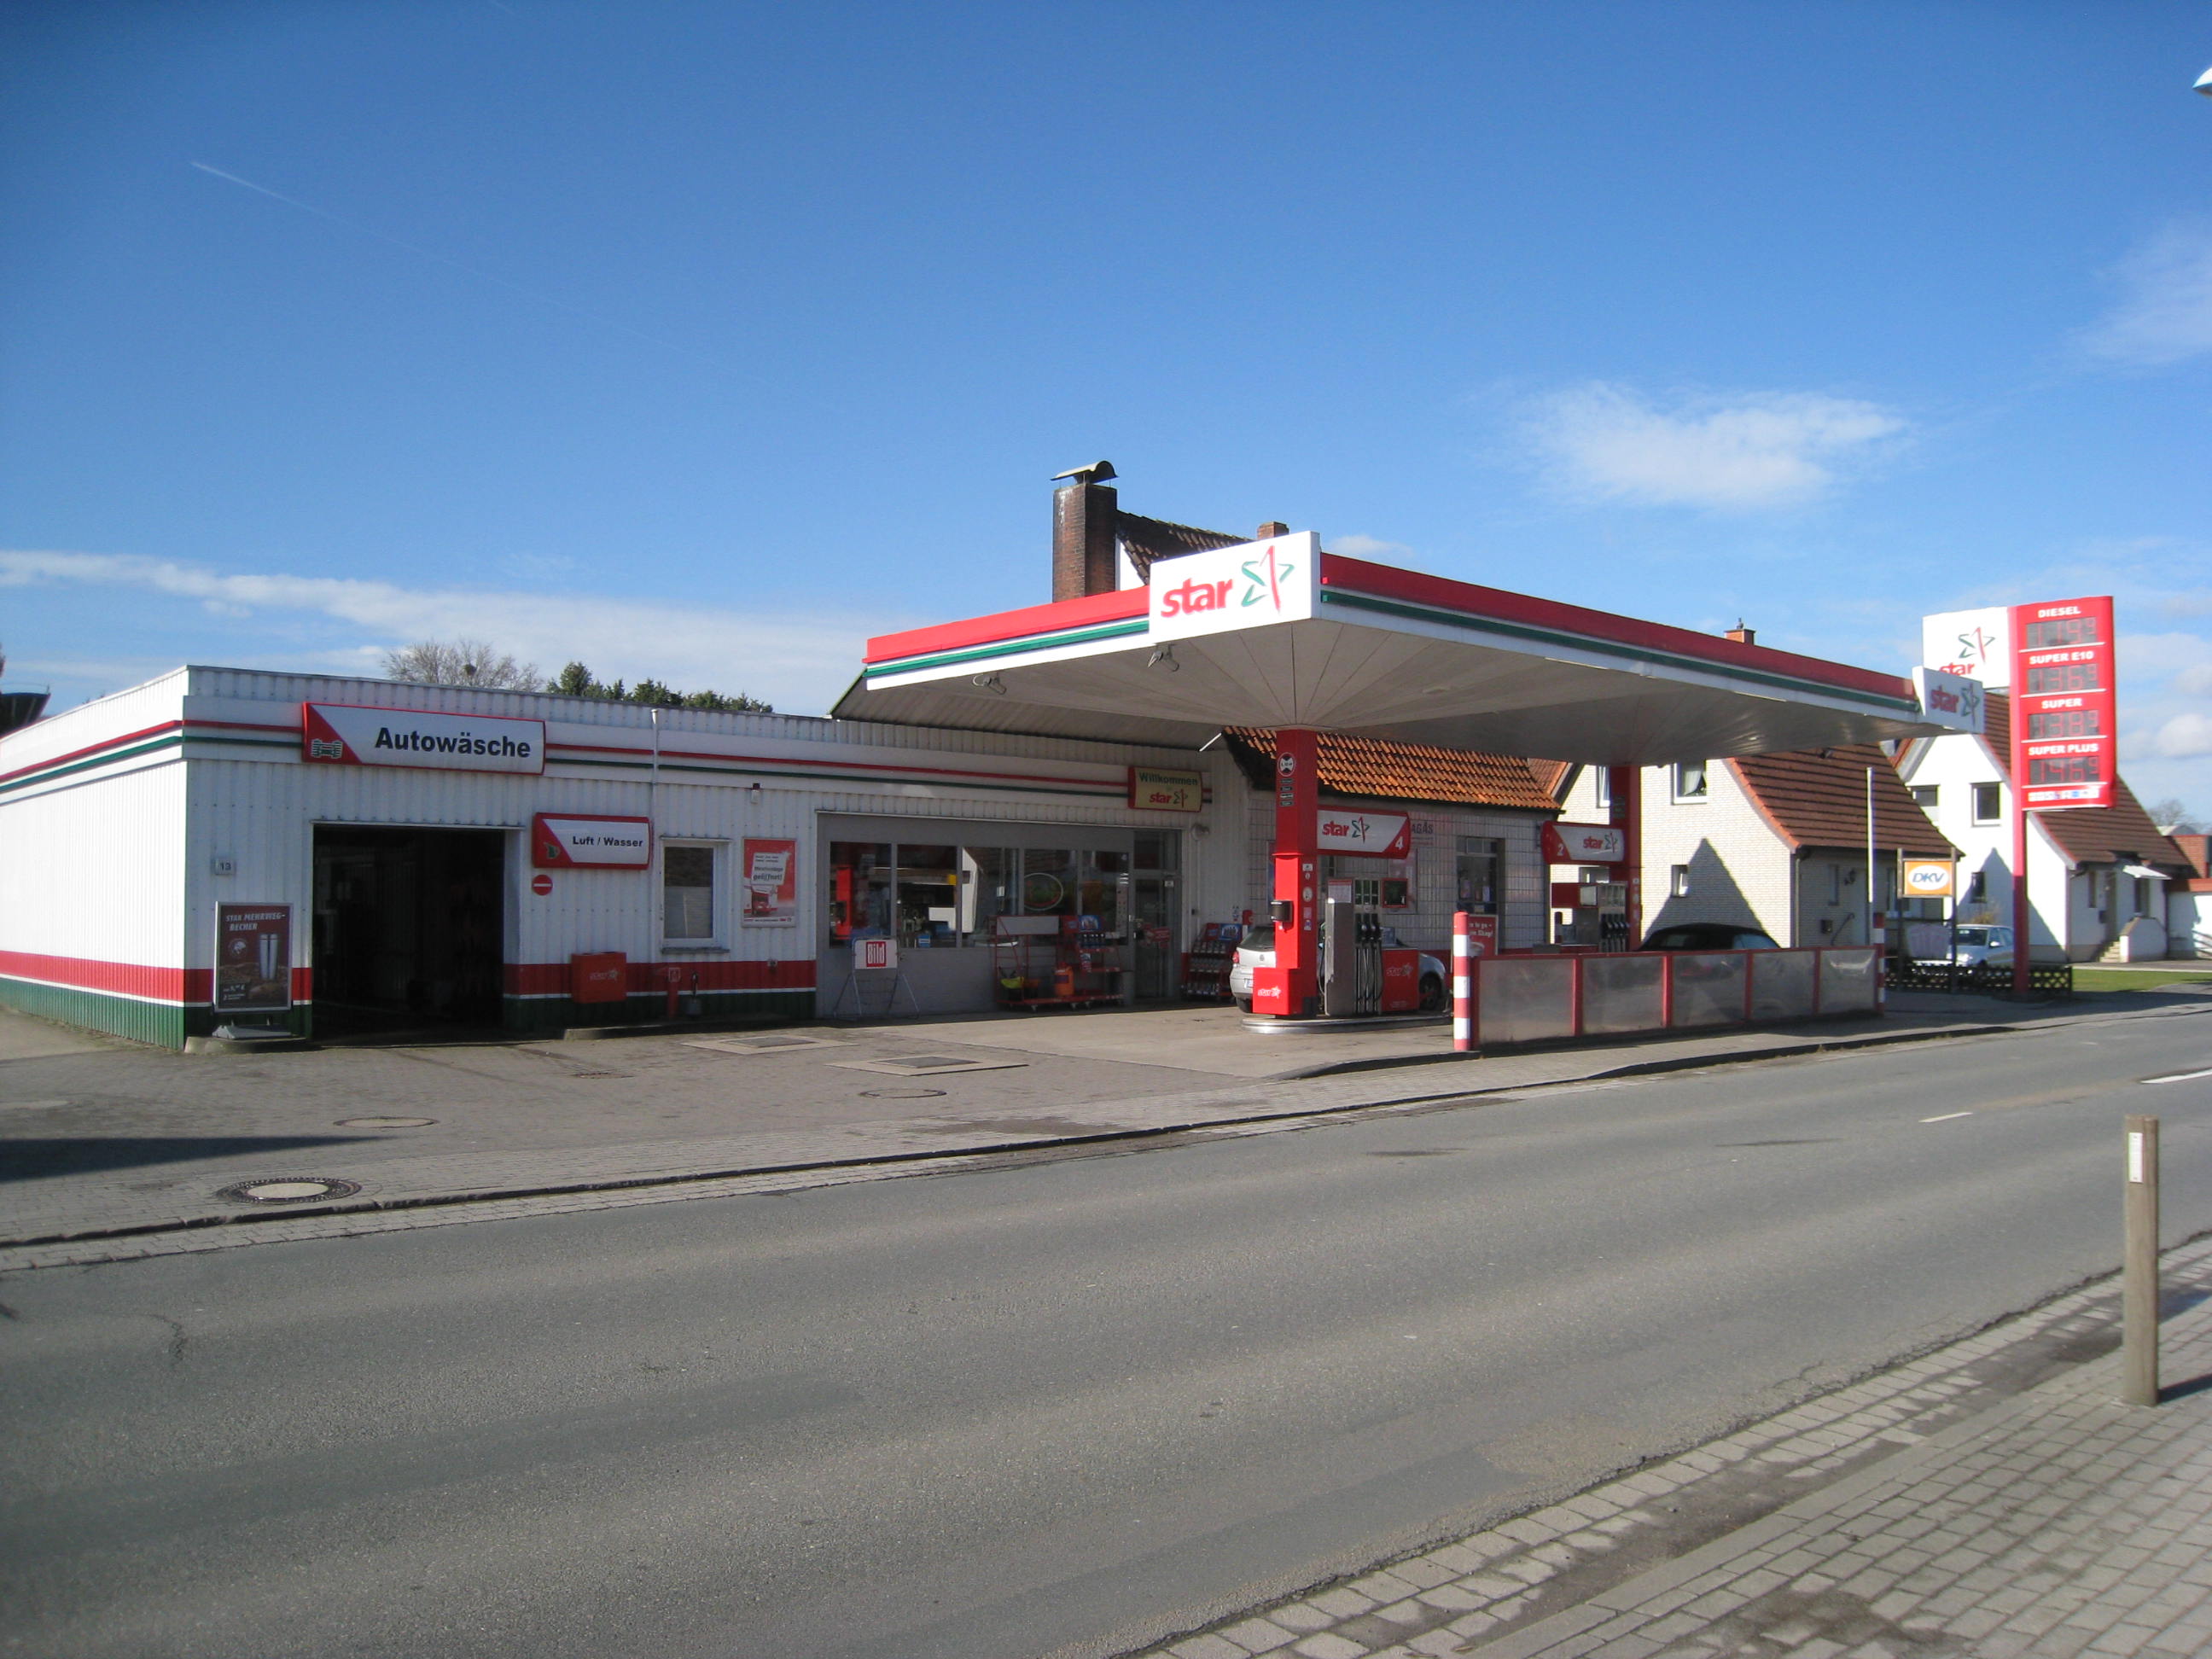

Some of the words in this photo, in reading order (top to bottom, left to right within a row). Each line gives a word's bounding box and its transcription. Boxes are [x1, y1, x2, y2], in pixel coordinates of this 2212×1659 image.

[1161, 578, 1233, 618] star
[2037, 606, 2081, 618] DIESEL
[2029, 653, 2069, 664] SUPER
[2071, 651, 2094, 661] E10
[1930, 684, 1959, 713] star
[2040, 697, 2082, 709] SUPER
[375, 727, 532, 758] Autowäsche
[2028, 745, 2065, 755] SUPER
[2068, 743, 2099, 753] PLUS
[1139, 771, 1198, 785] Willkommen
[1149, 791, 1173, 804] star
[1322, 820, 1350, 837] star
[573, 835, 595, 846] Luft
[603, 837, 643, 847] Wasser
[1394, 835, 1404, 850] 4
[1583, 835, 1604, 850] star
[1557, 843, 1565, 856] 2
[1912, 871, 1945, 883] DKV
[868, 943, 885, 963] Bild
